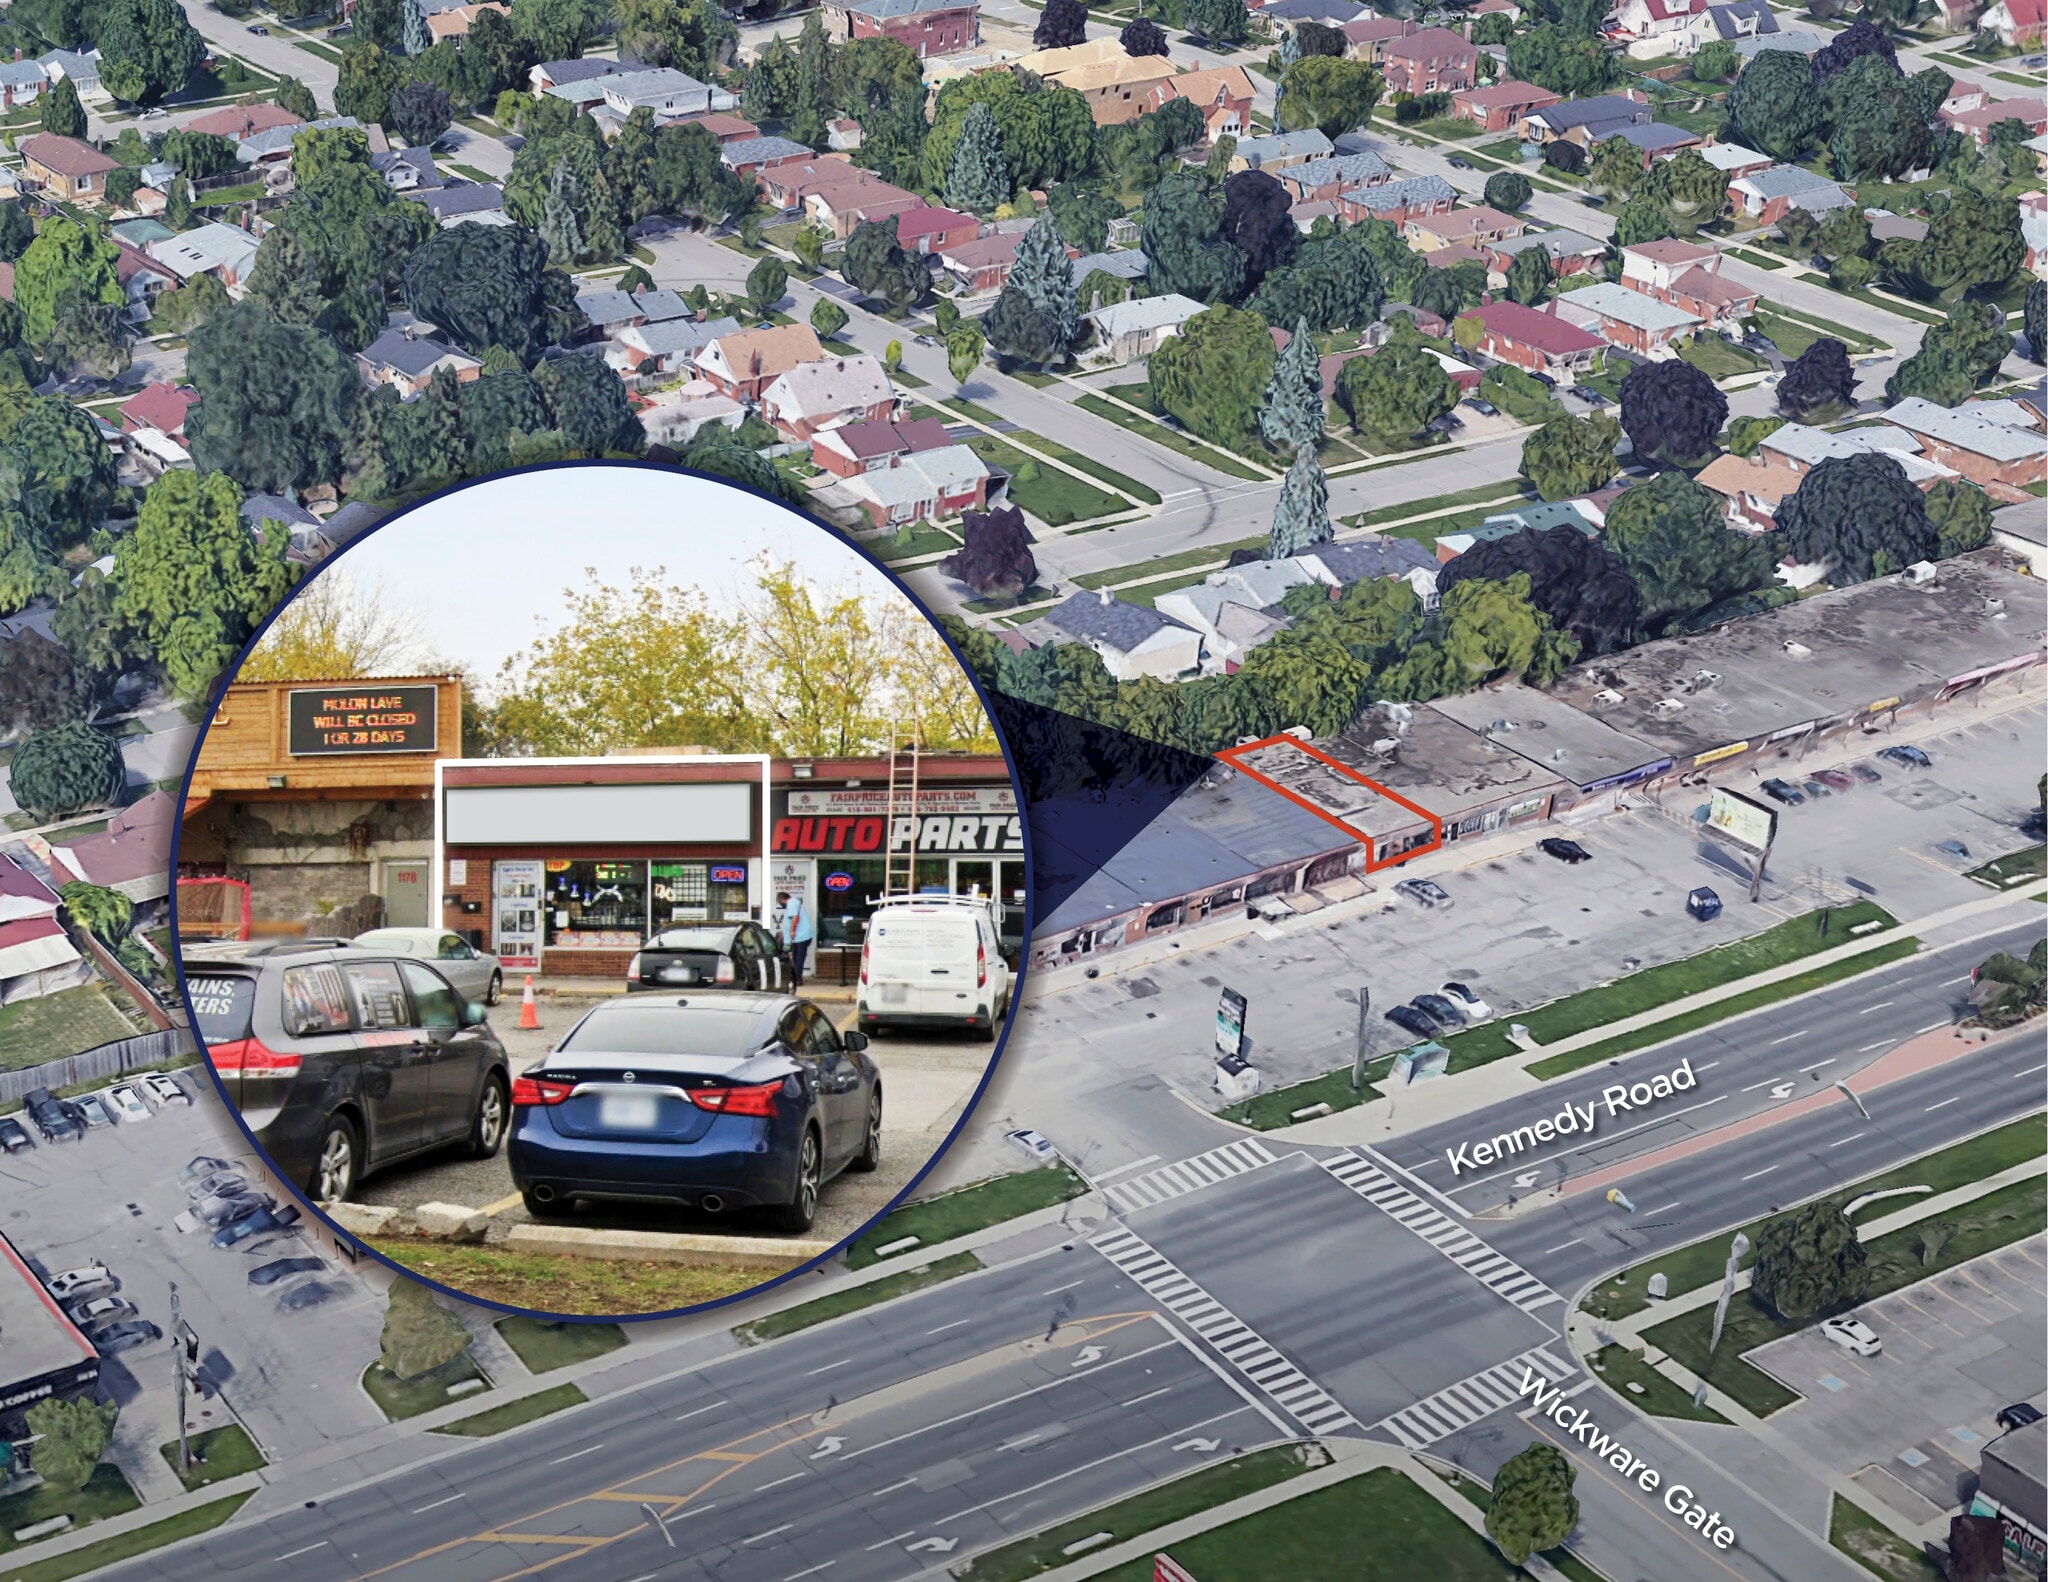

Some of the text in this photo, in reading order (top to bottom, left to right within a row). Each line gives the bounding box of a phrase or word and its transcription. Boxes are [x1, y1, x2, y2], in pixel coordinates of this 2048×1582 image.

[313, 715, 345, 728] WILL
[366, 712, 416, 726] CLOSED
[352, 731, 368, 744] 28
[371, 730, 405, 743] DAYS
[831, 791, 976, 802] FAIRPRICEUTPARTS.COM
[772, 816, 1024, 850] AUTO PARTS
[714, 869, 744, 880] OPEN
[827, 875, 851, 887] OPEN
[186, 978, 236, 997] AINS,
